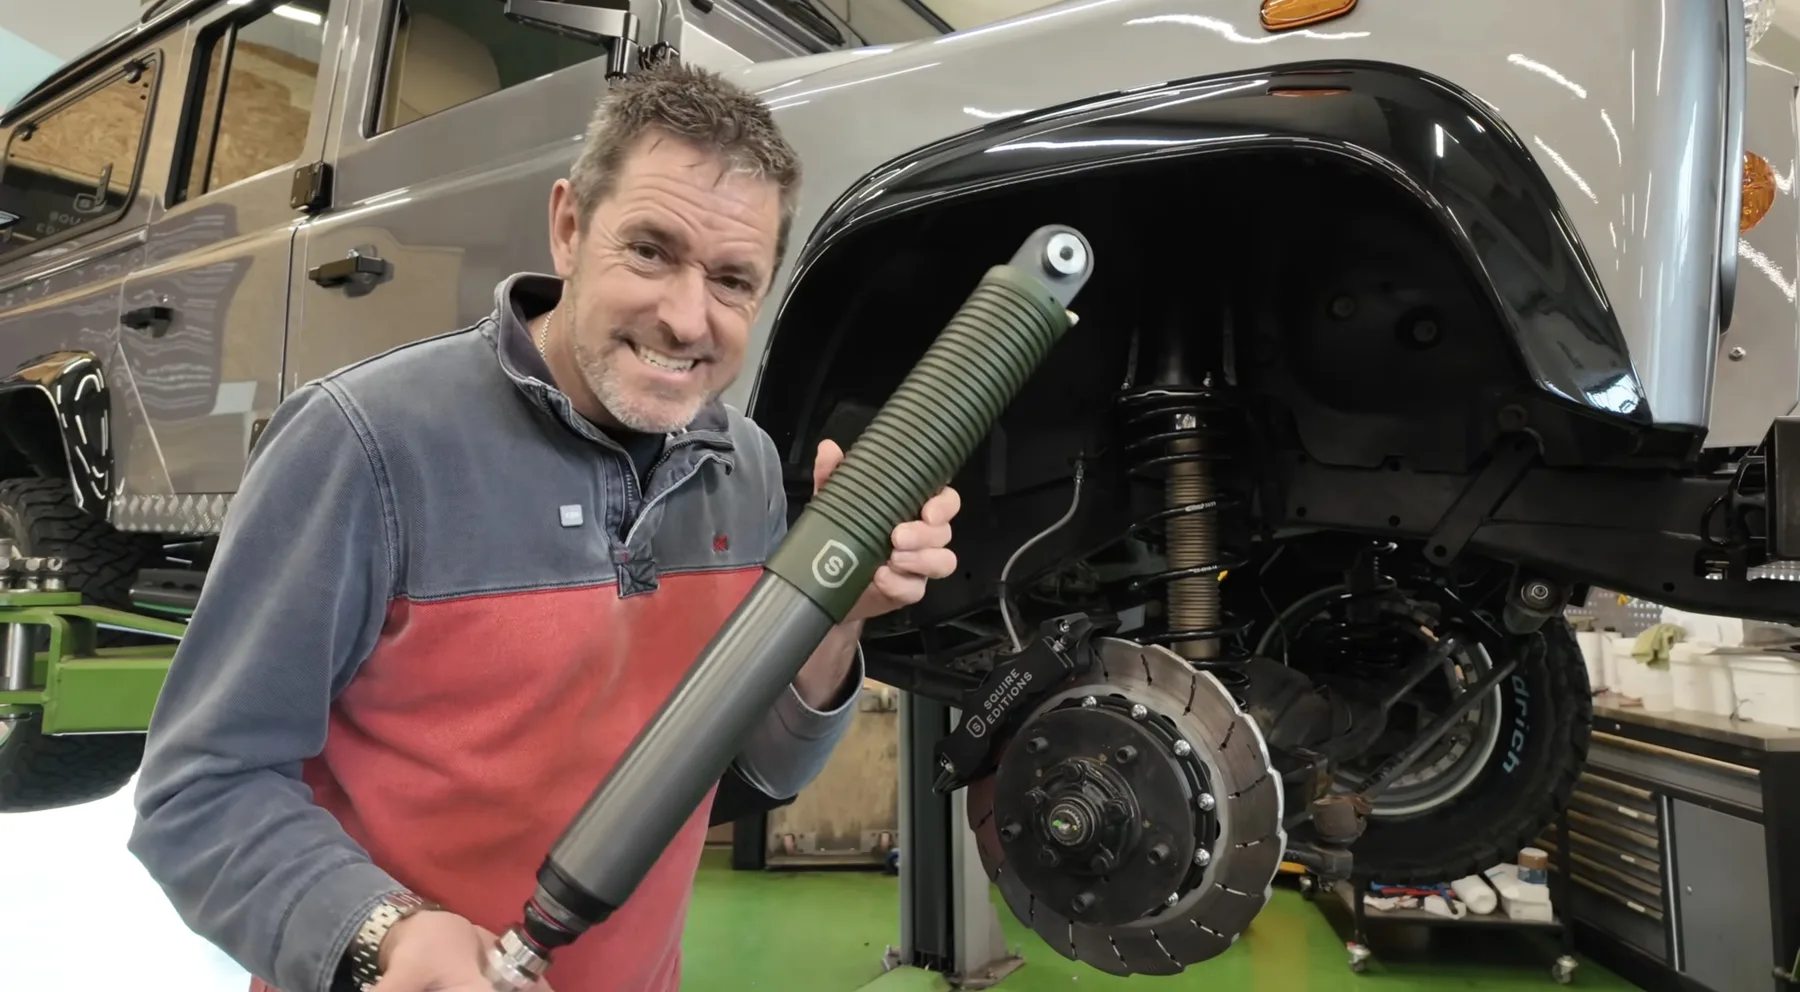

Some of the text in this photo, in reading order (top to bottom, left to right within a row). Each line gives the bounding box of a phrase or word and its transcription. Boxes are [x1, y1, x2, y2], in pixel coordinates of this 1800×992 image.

[824, 555, 844, 577] S
[983, 668, 1020, 711] SQUIRE
[986, 671, 1033, 725] EDITIONS
